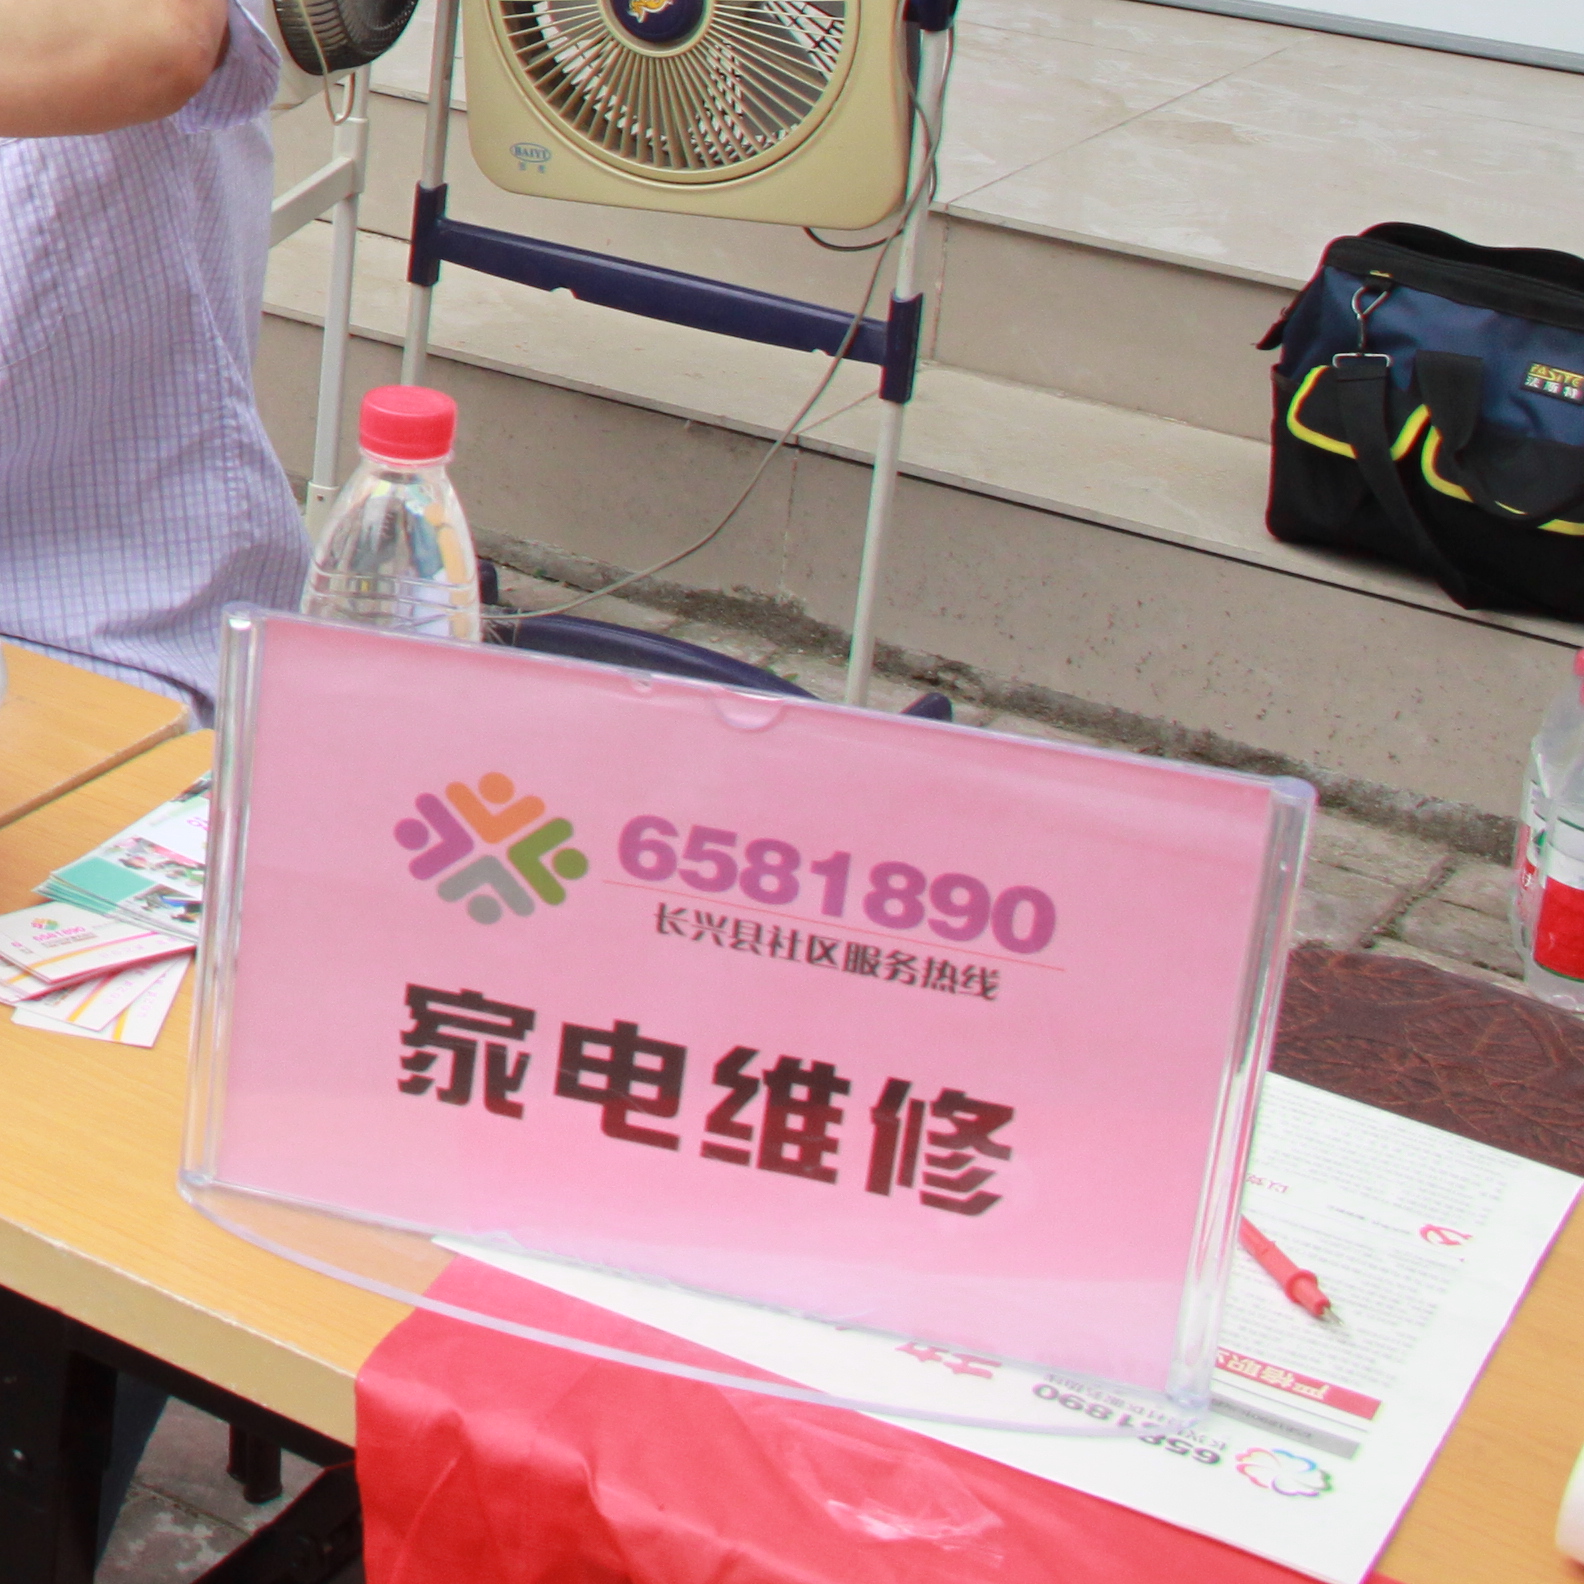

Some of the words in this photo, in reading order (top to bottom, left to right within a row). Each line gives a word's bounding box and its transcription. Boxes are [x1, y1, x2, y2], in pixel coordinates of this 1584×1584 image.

[618, 814, 1056, 955] 6581890
[654, 902, 1001, 1001] 长兴县社区服务热线
[397, 982, 1015, 1217] 家电维修
